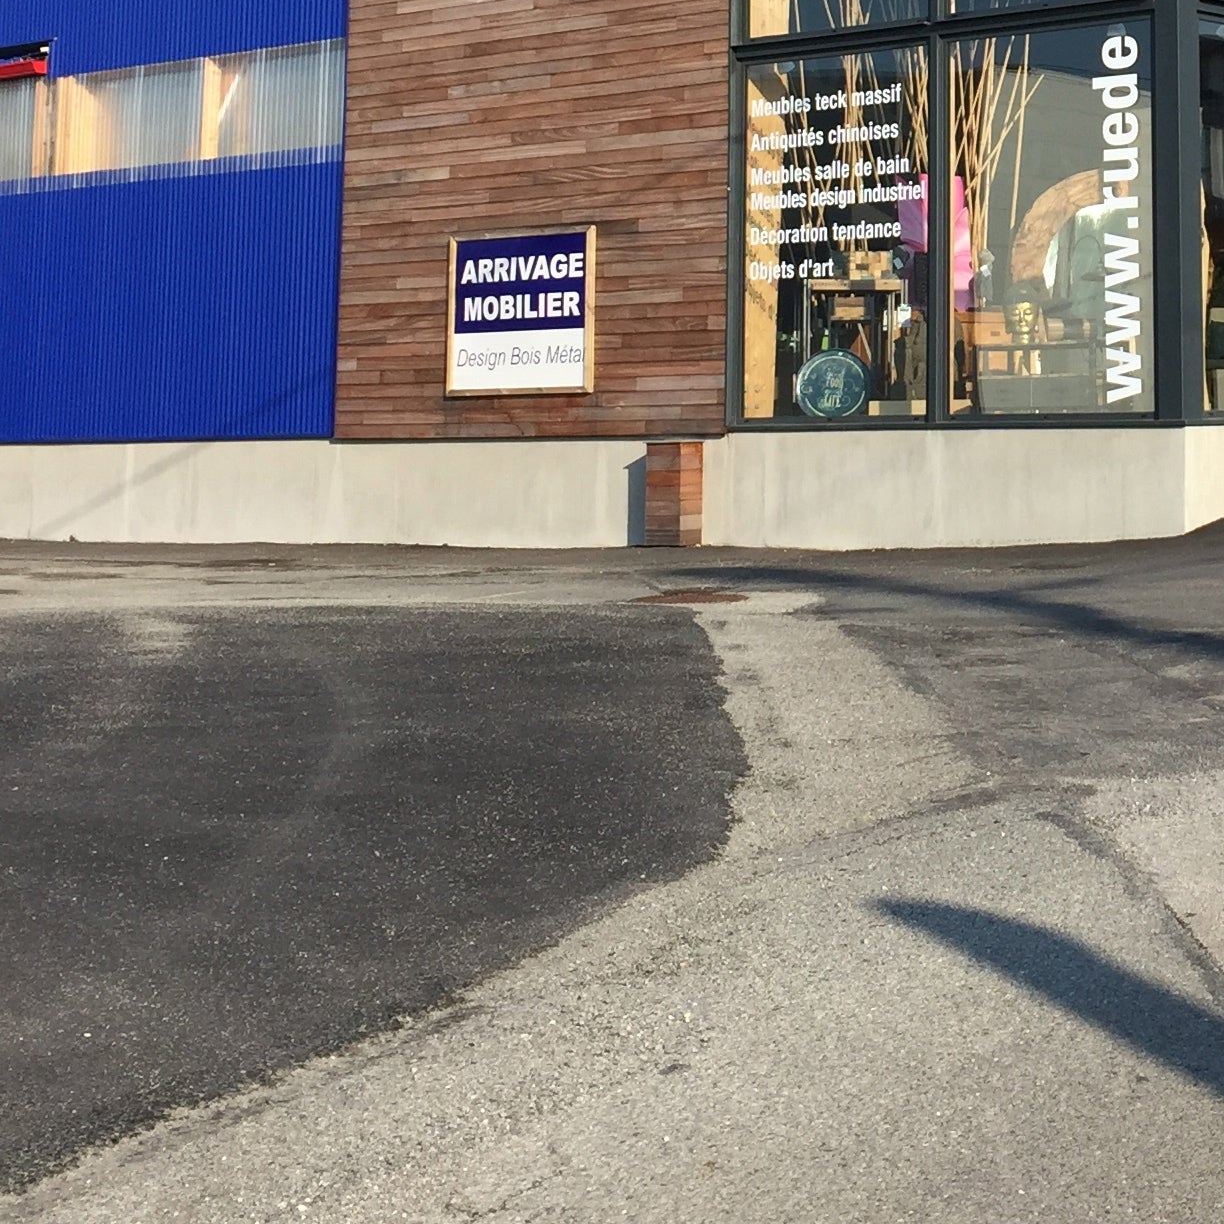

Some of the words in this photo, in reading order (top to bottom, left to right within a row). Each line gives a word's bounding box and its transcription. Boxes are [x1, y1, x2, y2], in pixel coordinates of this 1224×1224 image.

[751, 95, 811, 118] Meubles
[815, 90, 847, 111] teck
[852, 83, 902, 106] massif
[751, 126, 824, 153] Antiquités
[828, 122, 899, 145] chinoises
[751, 165, 811, 187] Meubles
[815, 160, 850, 182] salle
[854, 156, 873, 177] de
[877, 154, 910, 174] bain
[751, 189, 807, 211] Meubles
[811, 185, 855, 209] design
[859, 180, 926, 204] industriel
[750, 222, 828, 246] Décoration
[832, 219, 901, 241] tendance
[1092, 34, 1142, 404] www.ruede
[461, 252, 584, 285] ARRIVAGE
[750, 259, 795, 283] Objets
[799, 258, 835, 278] d'art
[463, 291, 580, 322] MOBILIER
[457, 348, 507, 371] Design
[510, 346, 541, 366] Bois
